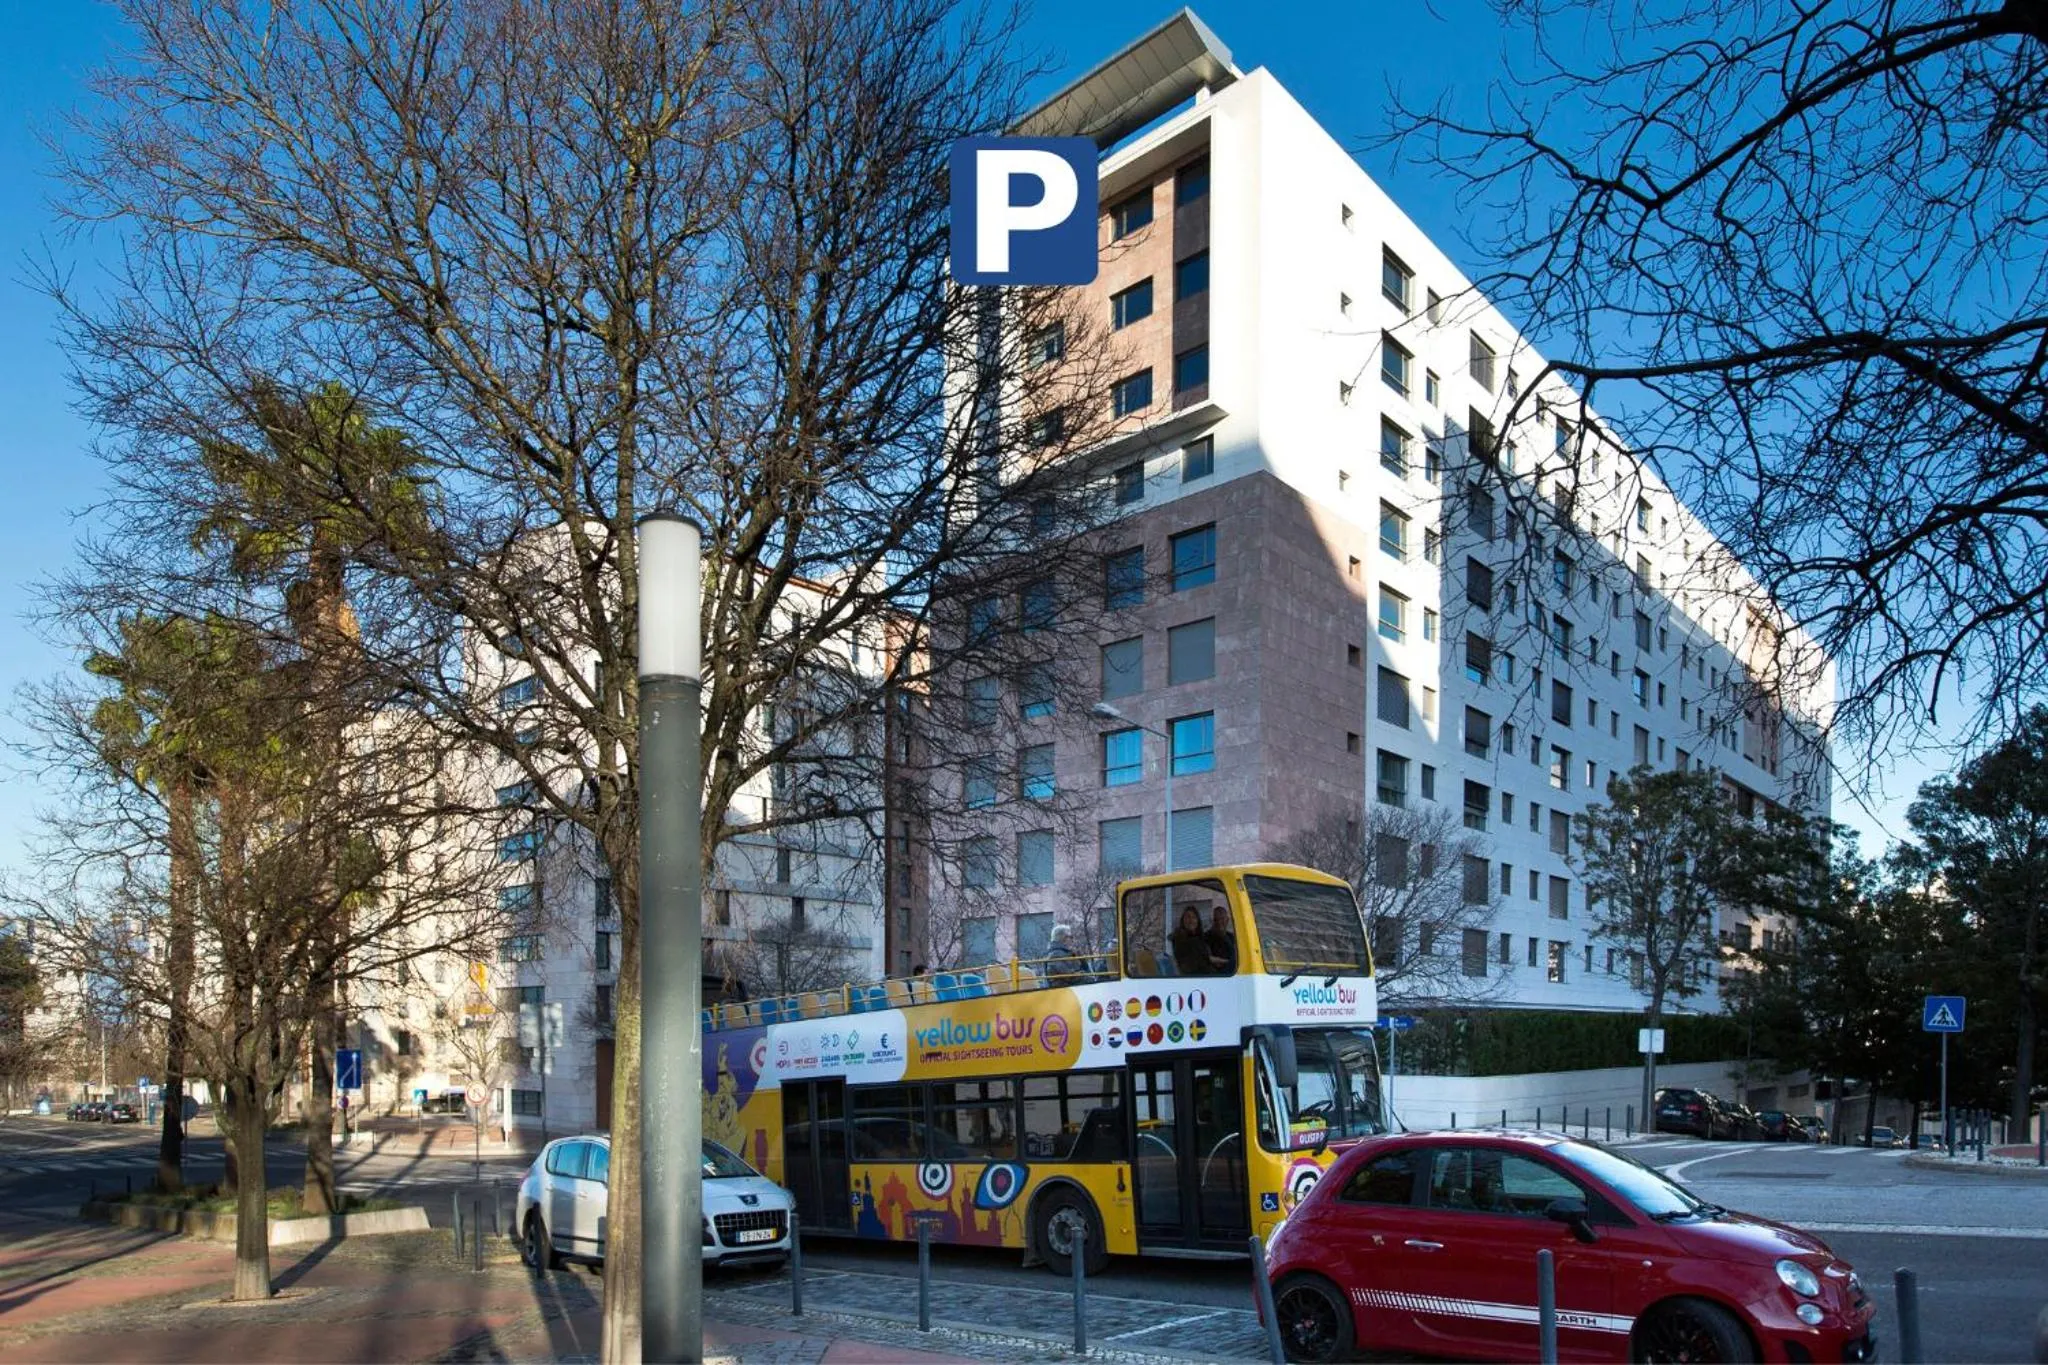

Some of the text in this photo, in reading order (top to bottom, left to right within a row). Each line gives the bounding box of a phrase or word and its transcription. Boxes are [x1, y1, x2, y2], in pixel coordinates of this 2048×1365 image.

[1293, 983, 1357, 1005] yellow bus
[915, 1013, 1035, 1048] yellow bus
[953, 1047, 1004, 1061] SIGHTSEEING
[1006, 1044, 1034, 1057] TOURS
[1555, 1312, 1597, 1326] BARTH
